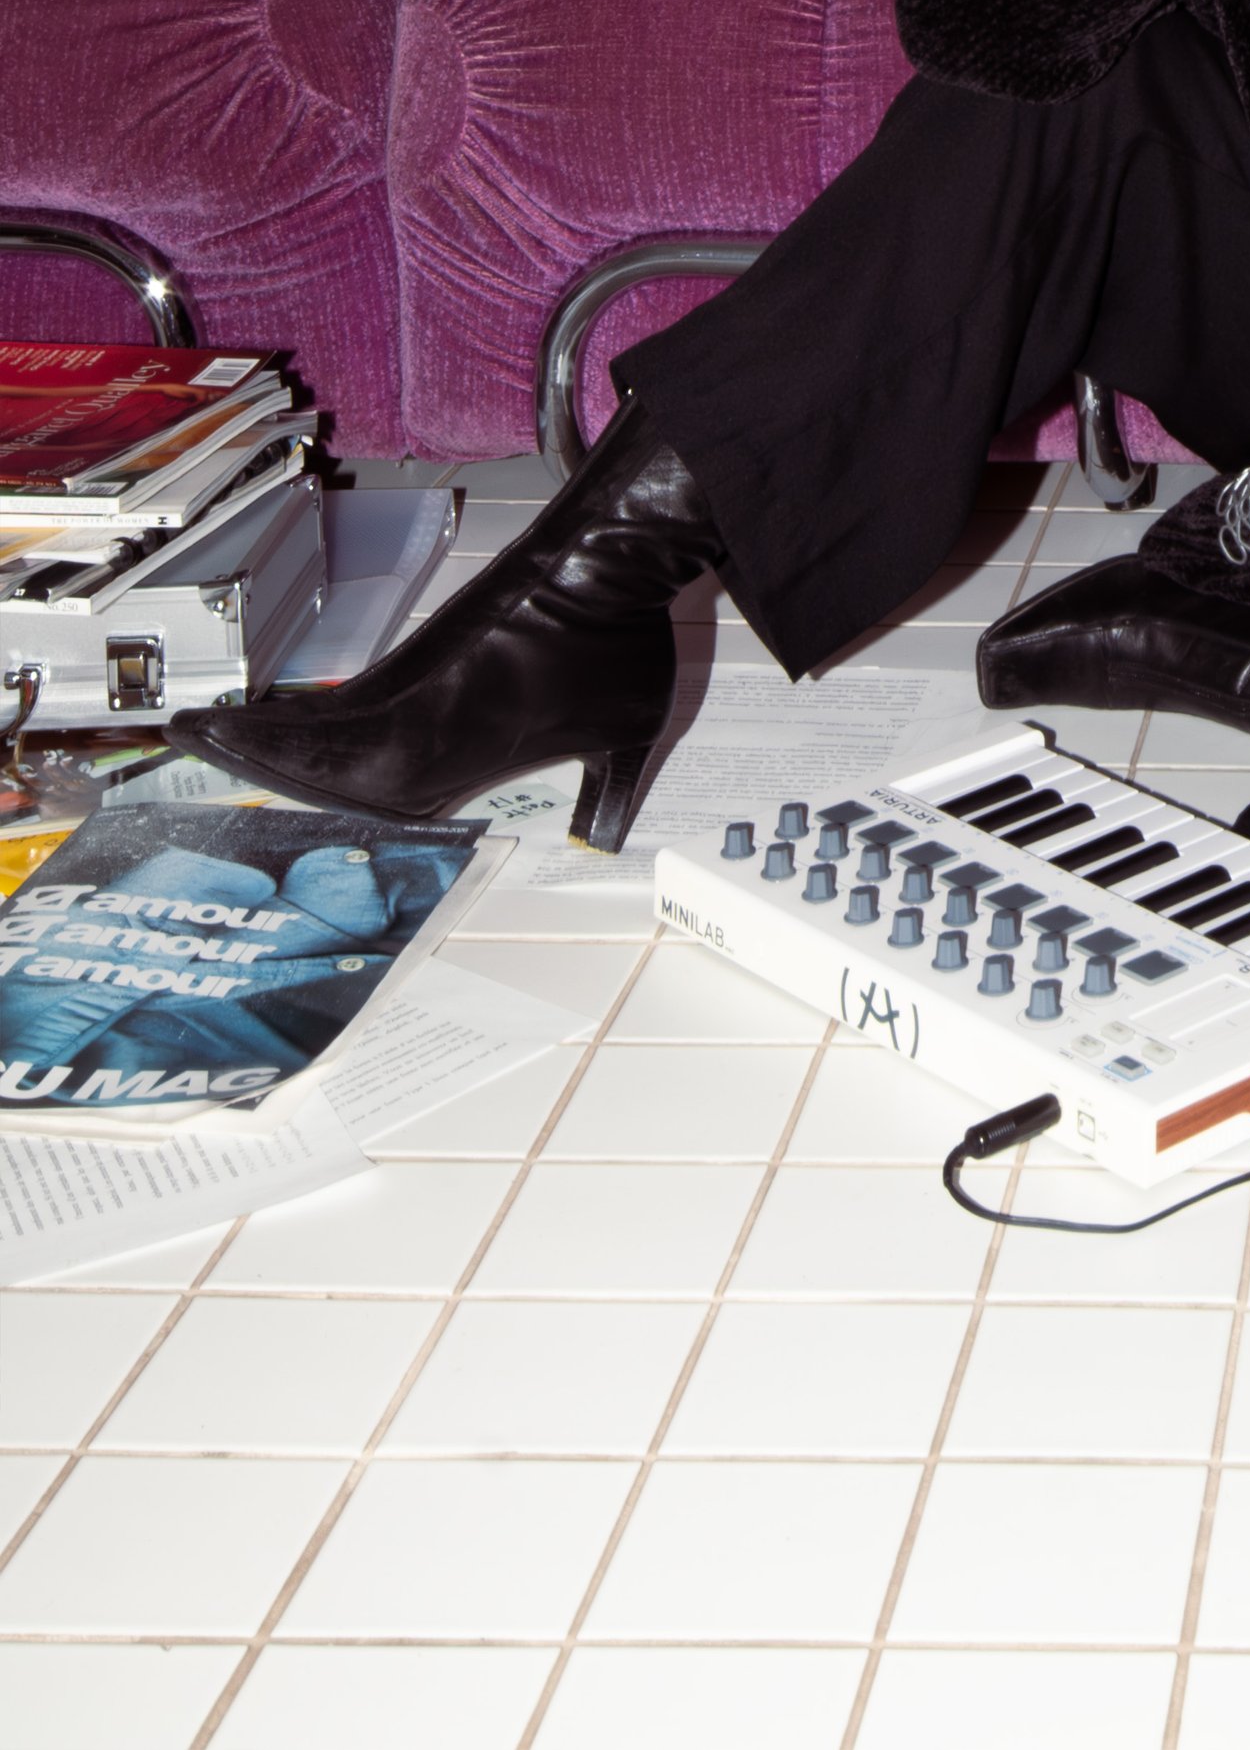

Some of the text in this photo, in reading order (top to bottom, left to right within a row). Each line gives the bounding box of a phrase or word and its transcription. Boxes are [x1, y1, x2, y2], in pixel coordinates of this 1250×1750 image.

[869, 788, 941, 825] ARTURIA
[83, 892, 300, 932] amour
[661, 895, 725, 948] MINILAB
[54, 923, 278, 964] amour
[23, 954, 251, 999] amour
[0, 1060, 280, 1101] U MAG
